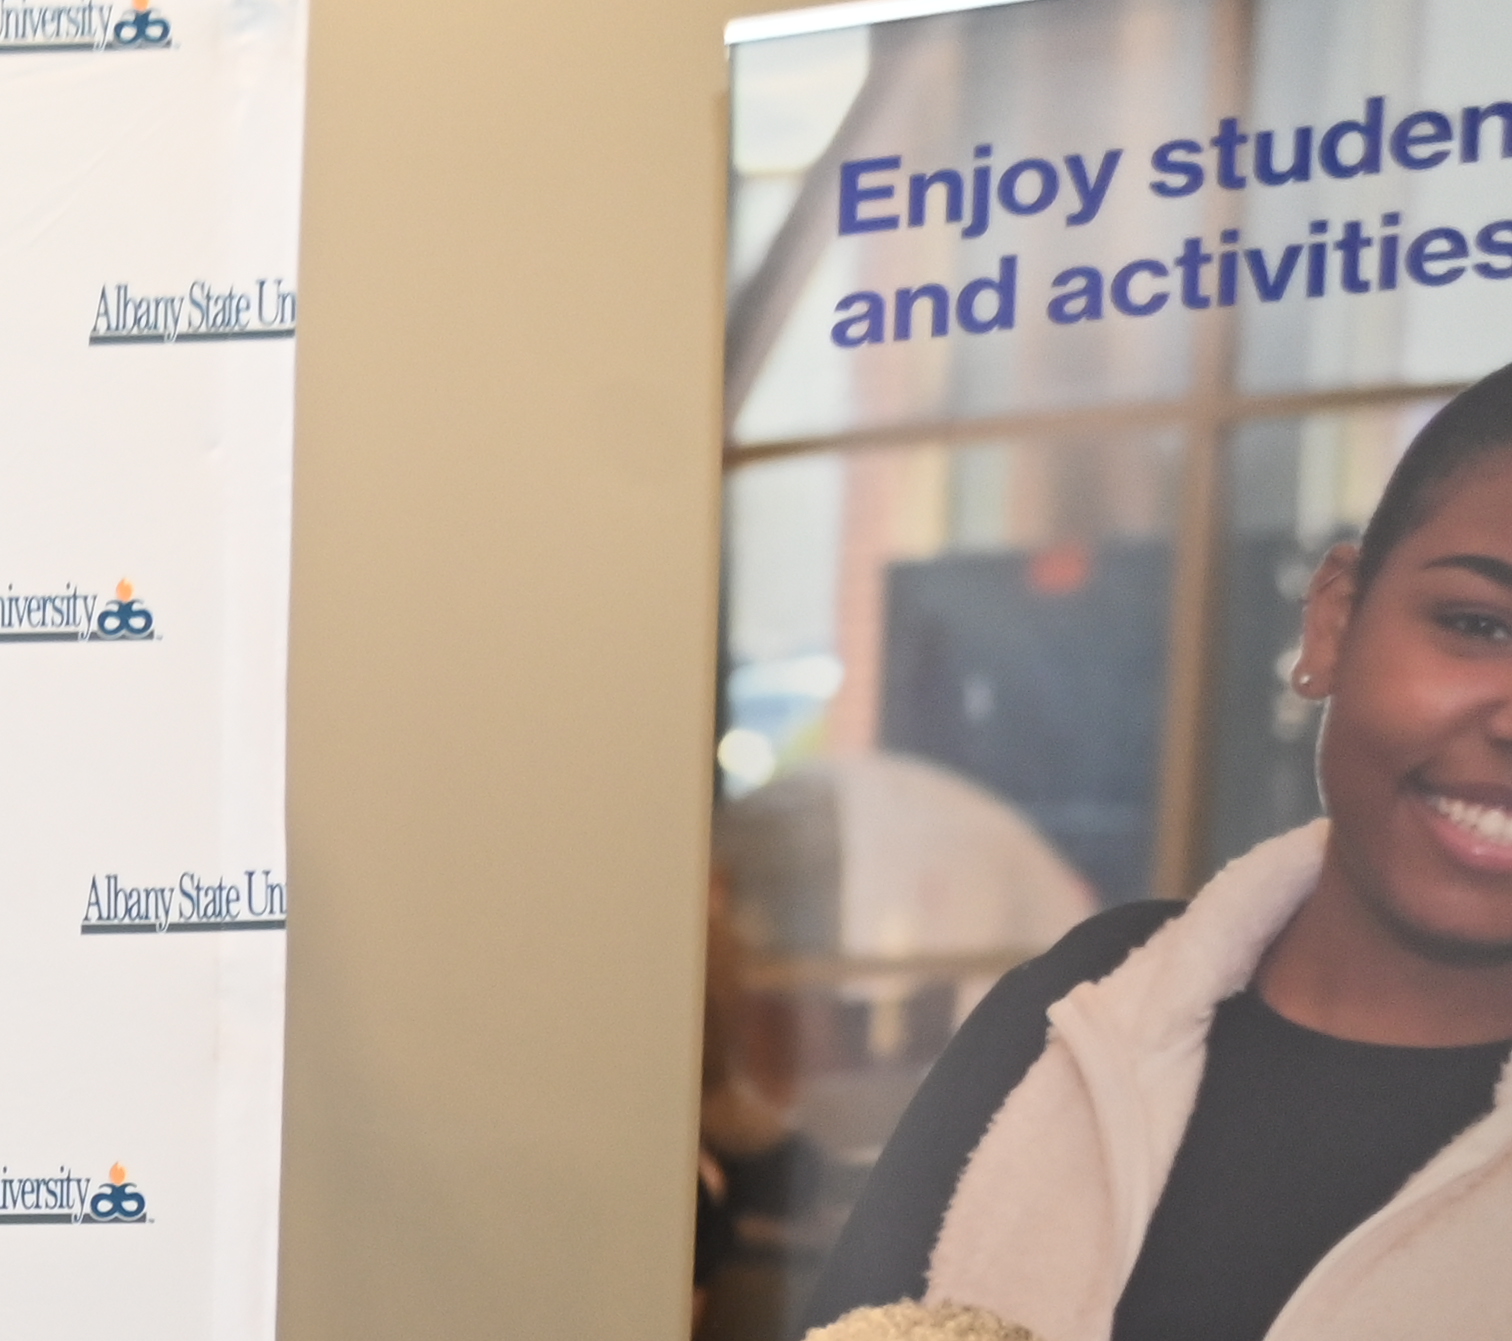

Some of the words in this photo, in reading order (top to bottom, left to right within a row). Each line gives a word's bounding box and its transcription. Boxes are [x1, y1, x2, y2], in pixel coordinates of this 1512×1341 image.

[839, 144, 1123, 241] Enjoy
[91, 285, 185, 342] Albany
[187, 281, 251, 330] State
[831, 255, 1019, 349] and
[1048, 211, 1512, 326] activities
[83, 875, 175, 932] Albany
[178, 872, 241, 921] State
